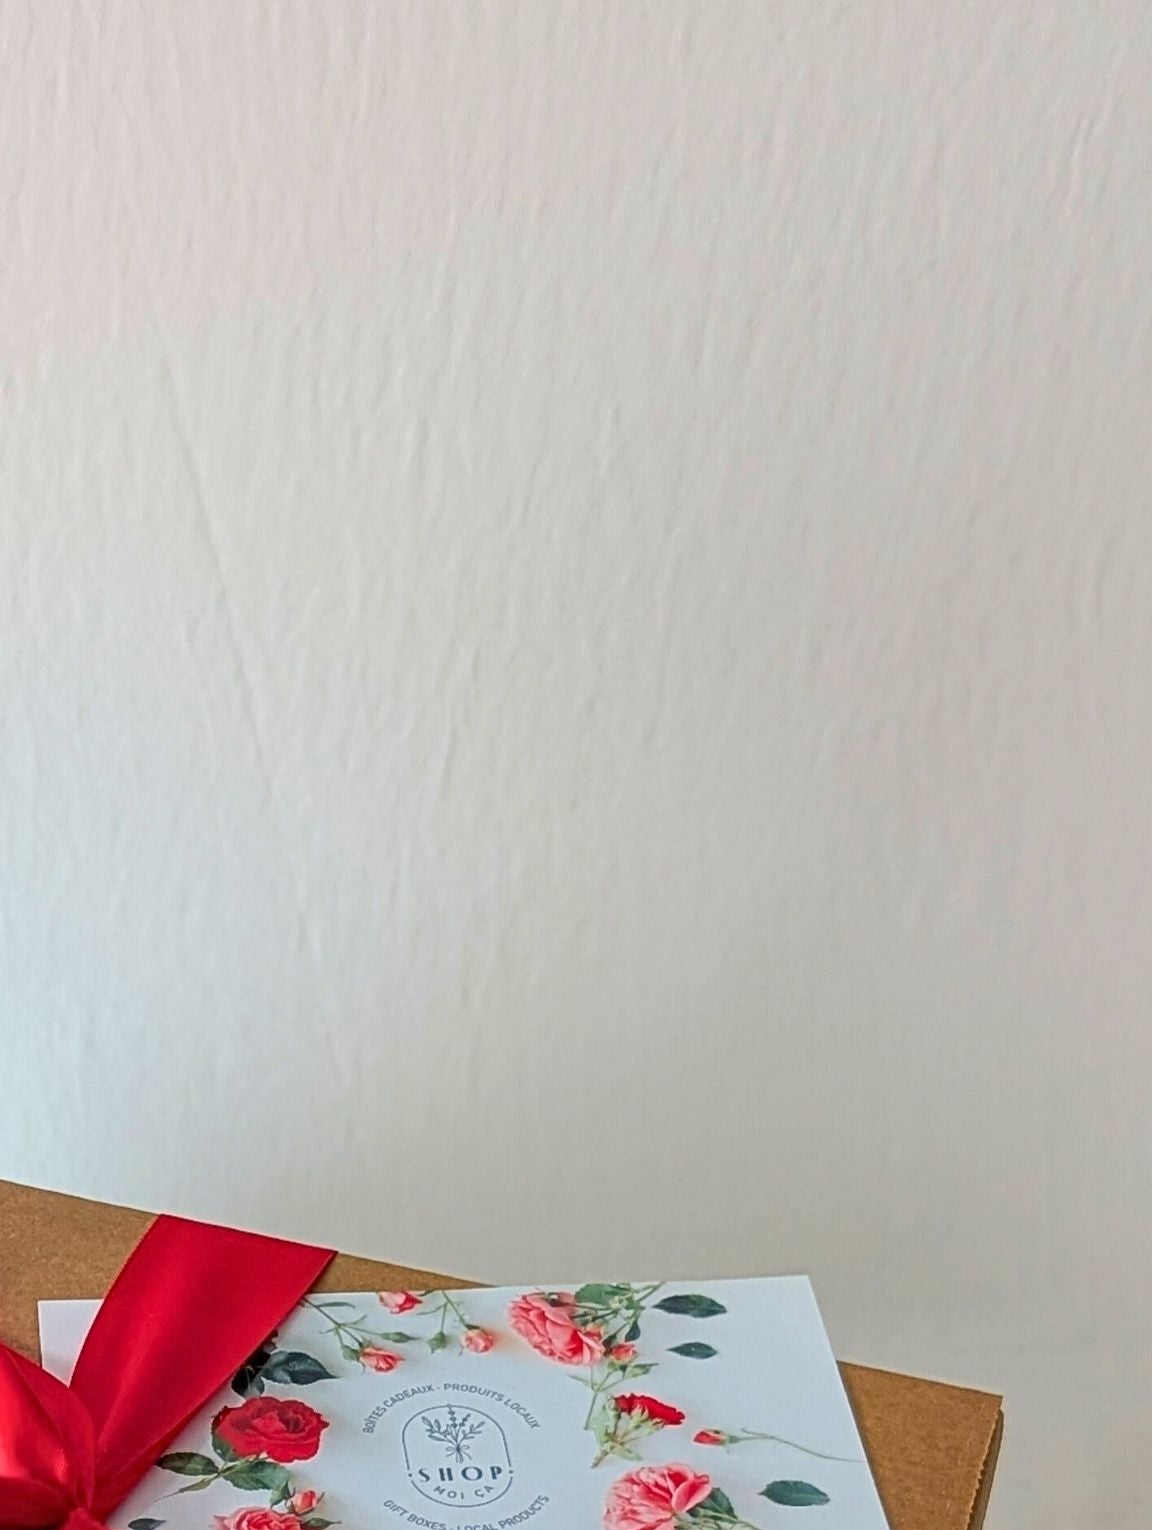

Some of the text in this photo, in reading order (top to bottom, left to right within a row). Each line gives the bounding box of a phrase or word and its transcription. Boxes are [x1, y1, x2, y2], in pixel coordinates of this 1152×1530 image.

[383, 1384, 434, 1408] CADEAUX
[443, 1383, 505, 1402] PRODUITS
[503, 1398, 540, 1429] LOCAUX
[418, 1465, 503, 1482] SHOP
[433, 1484, 495, 1499] MOI ÇA
[383, 1500, 409, 1517] GIFT
[498, 1494, 550, 1529] PRODUCTS
